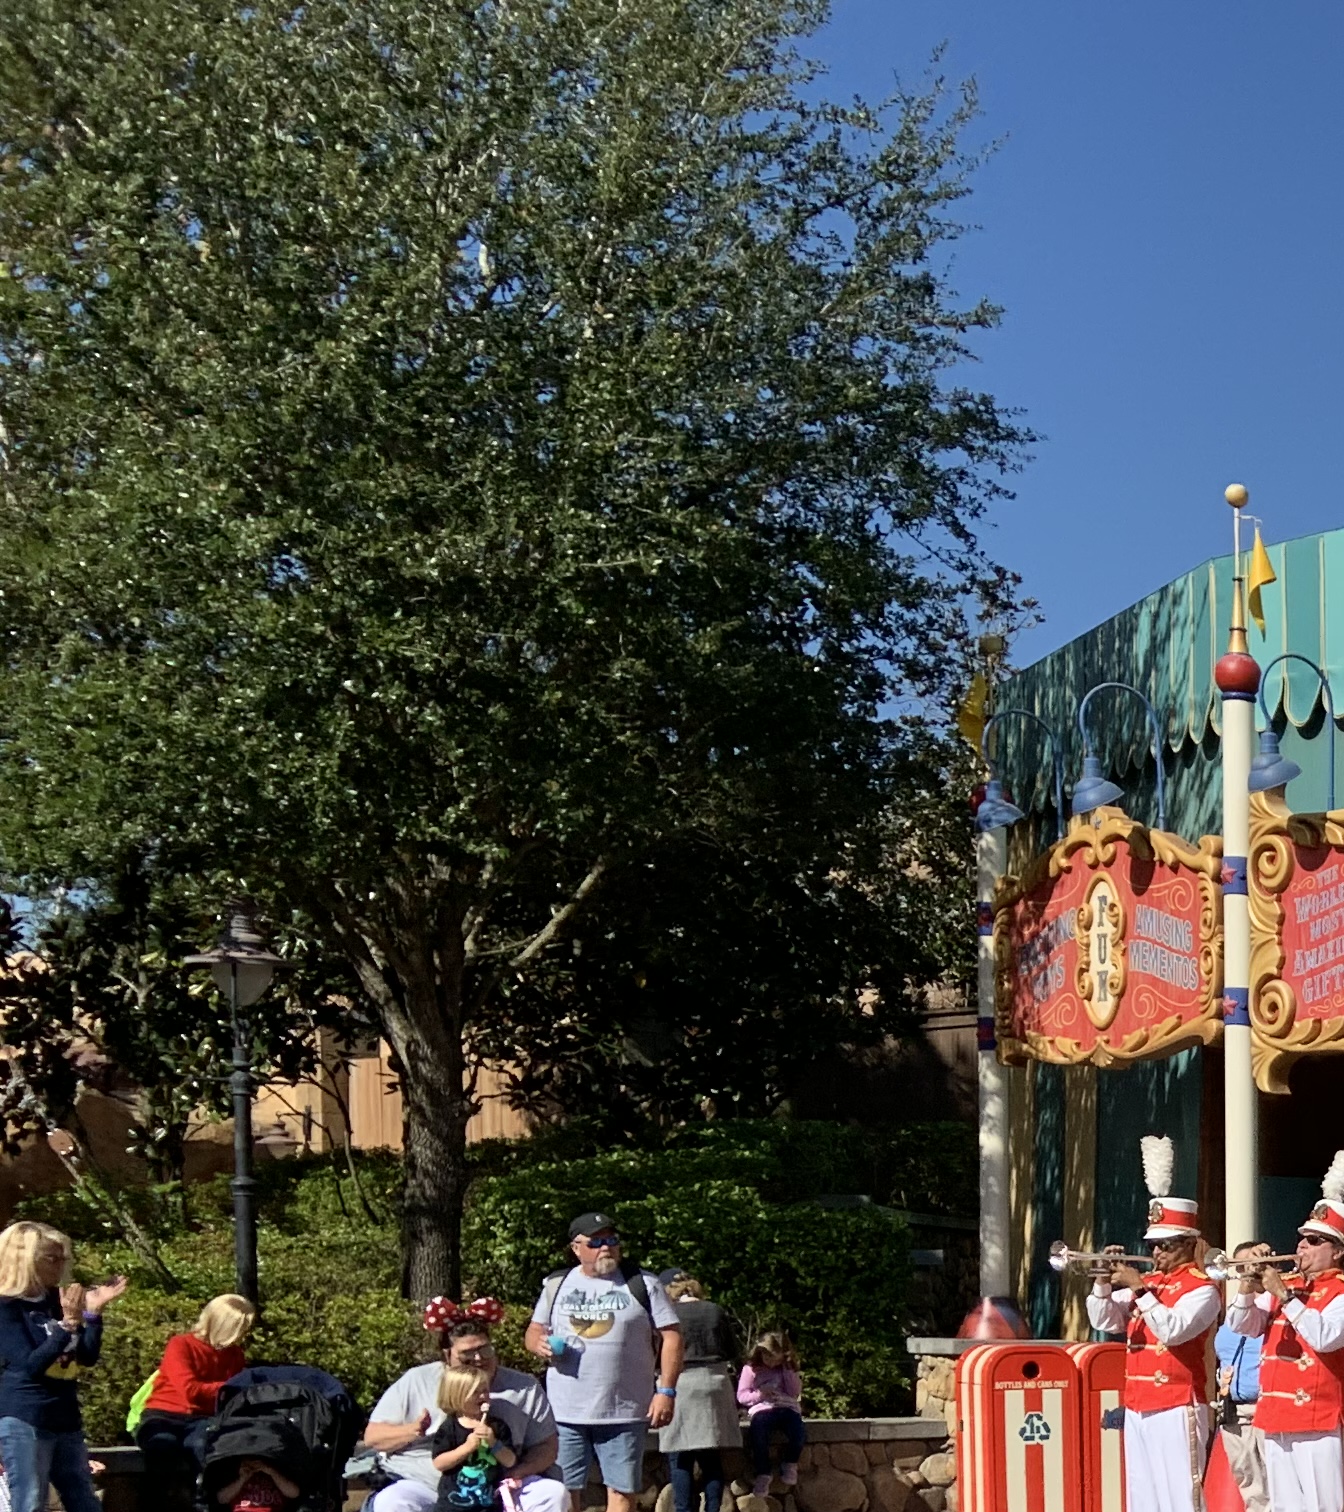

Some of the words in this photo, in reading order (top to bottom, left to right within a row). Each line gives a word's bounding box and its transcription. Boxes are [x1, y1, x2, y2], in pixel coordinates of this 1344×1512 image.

[1316, 864, 1340, 889] THE
[1135, 904, 1193, 954] AMUSING
[1129, 940, 1199, 991] MEMENTOS
